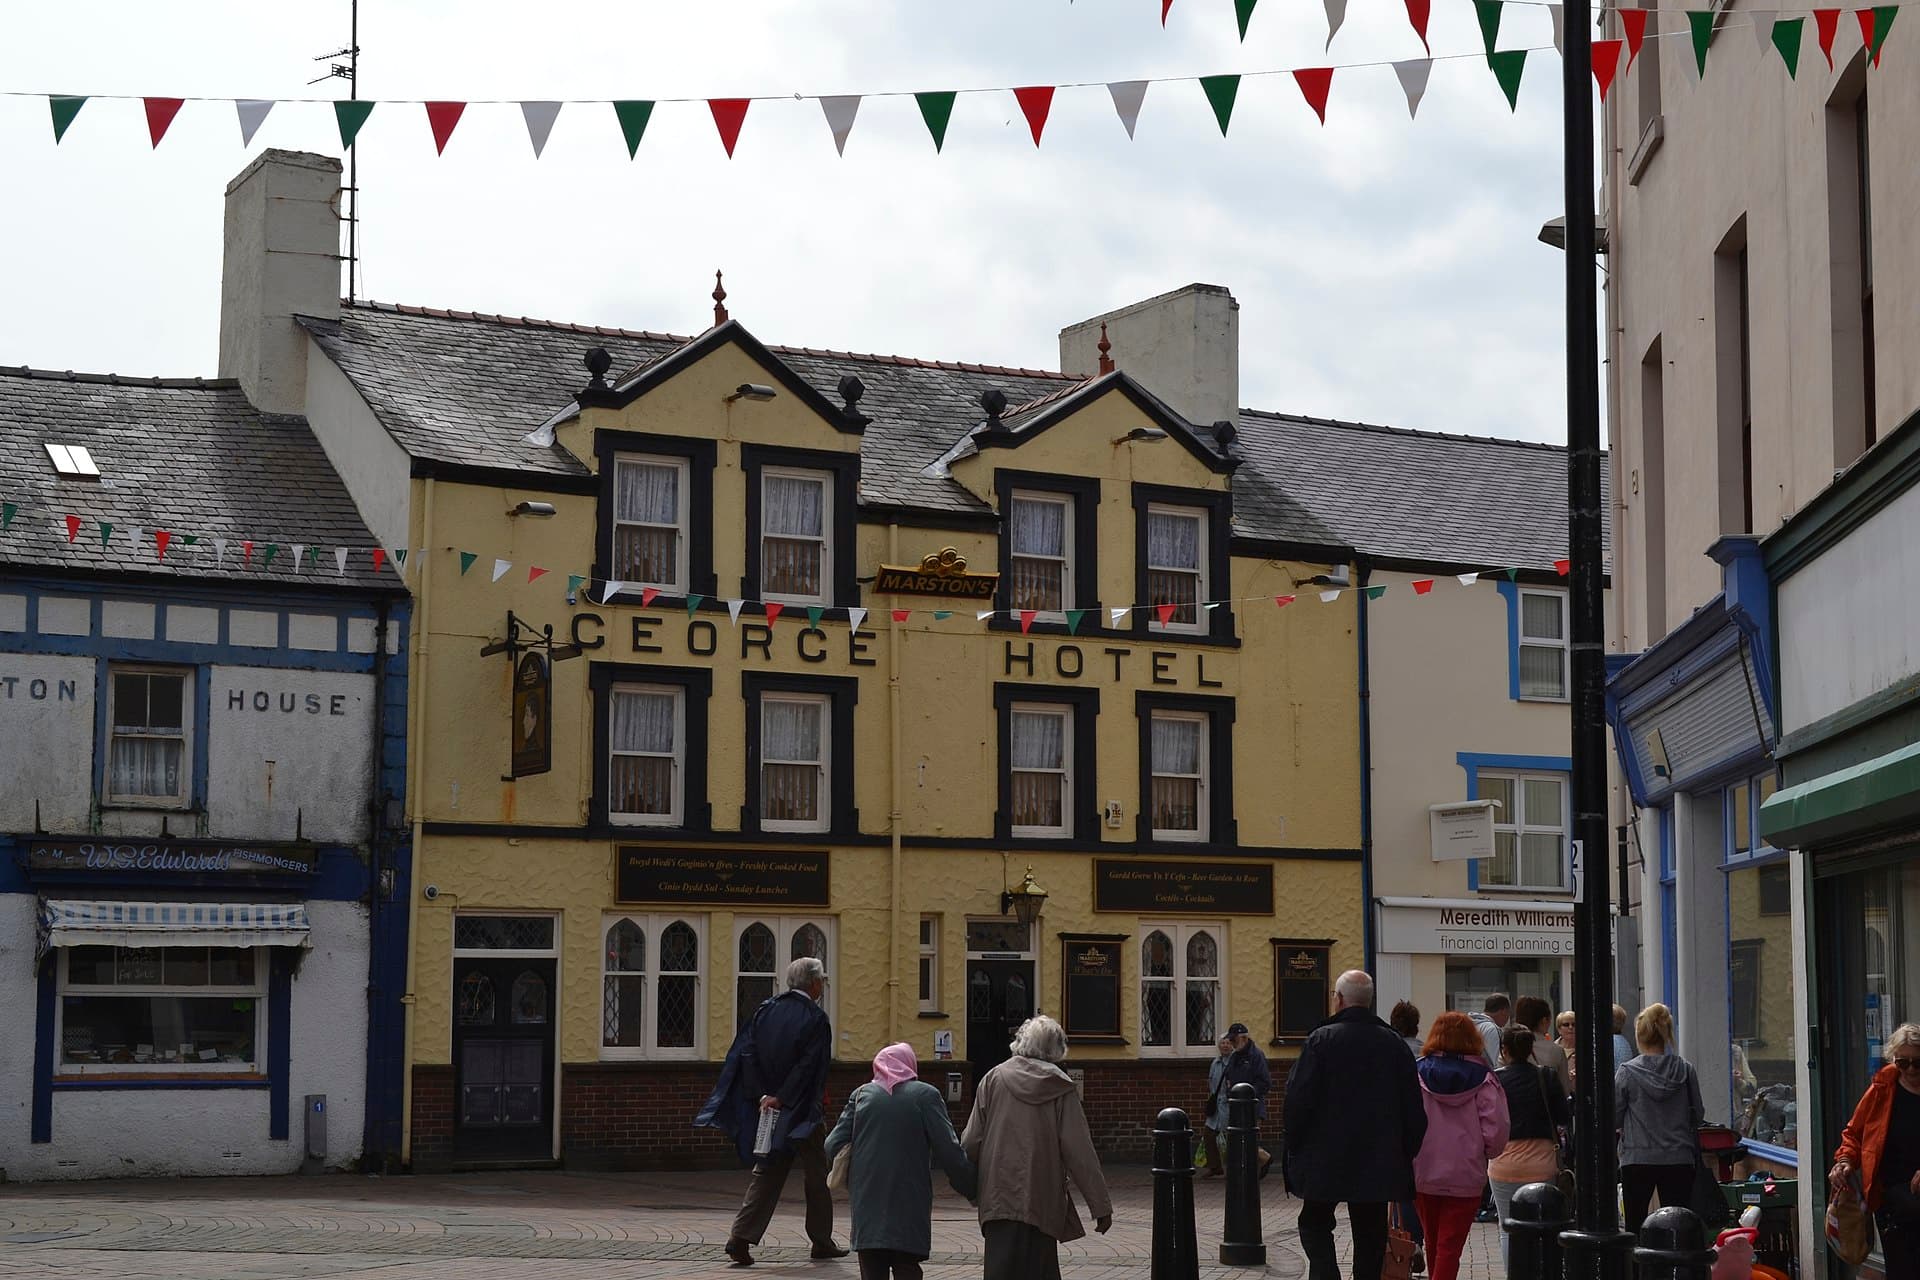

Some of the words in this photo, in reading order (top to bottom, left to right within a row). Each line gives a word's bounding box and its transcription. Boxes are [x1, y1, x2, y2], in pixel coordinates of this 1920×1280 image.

[883, 575, 991, 594] MARSTON'S
[571, 612, 876, 667] GEORGE
[1005, 641, 1222, 687] HOTEL
[229, 689, 345, 715] HOUSE
[232, 848, 308, 872] FISHMONGERS
[740, 860, 767, 872] Freshly
[769, 862, 797, 871] Cooked
[799, 863, 818, 872] Food
[1209, 873, 1233, 882] Garden
[725, 884, 754, 895] Sunday
[756, 885, 788, 895] Lunches
[1440, 908, 1509, 926] Meredith
[1514, 910, 1576, 928] Williams
[1441, 935, 1498, 950] financial
[1504, 936, 1560, 954] planning
